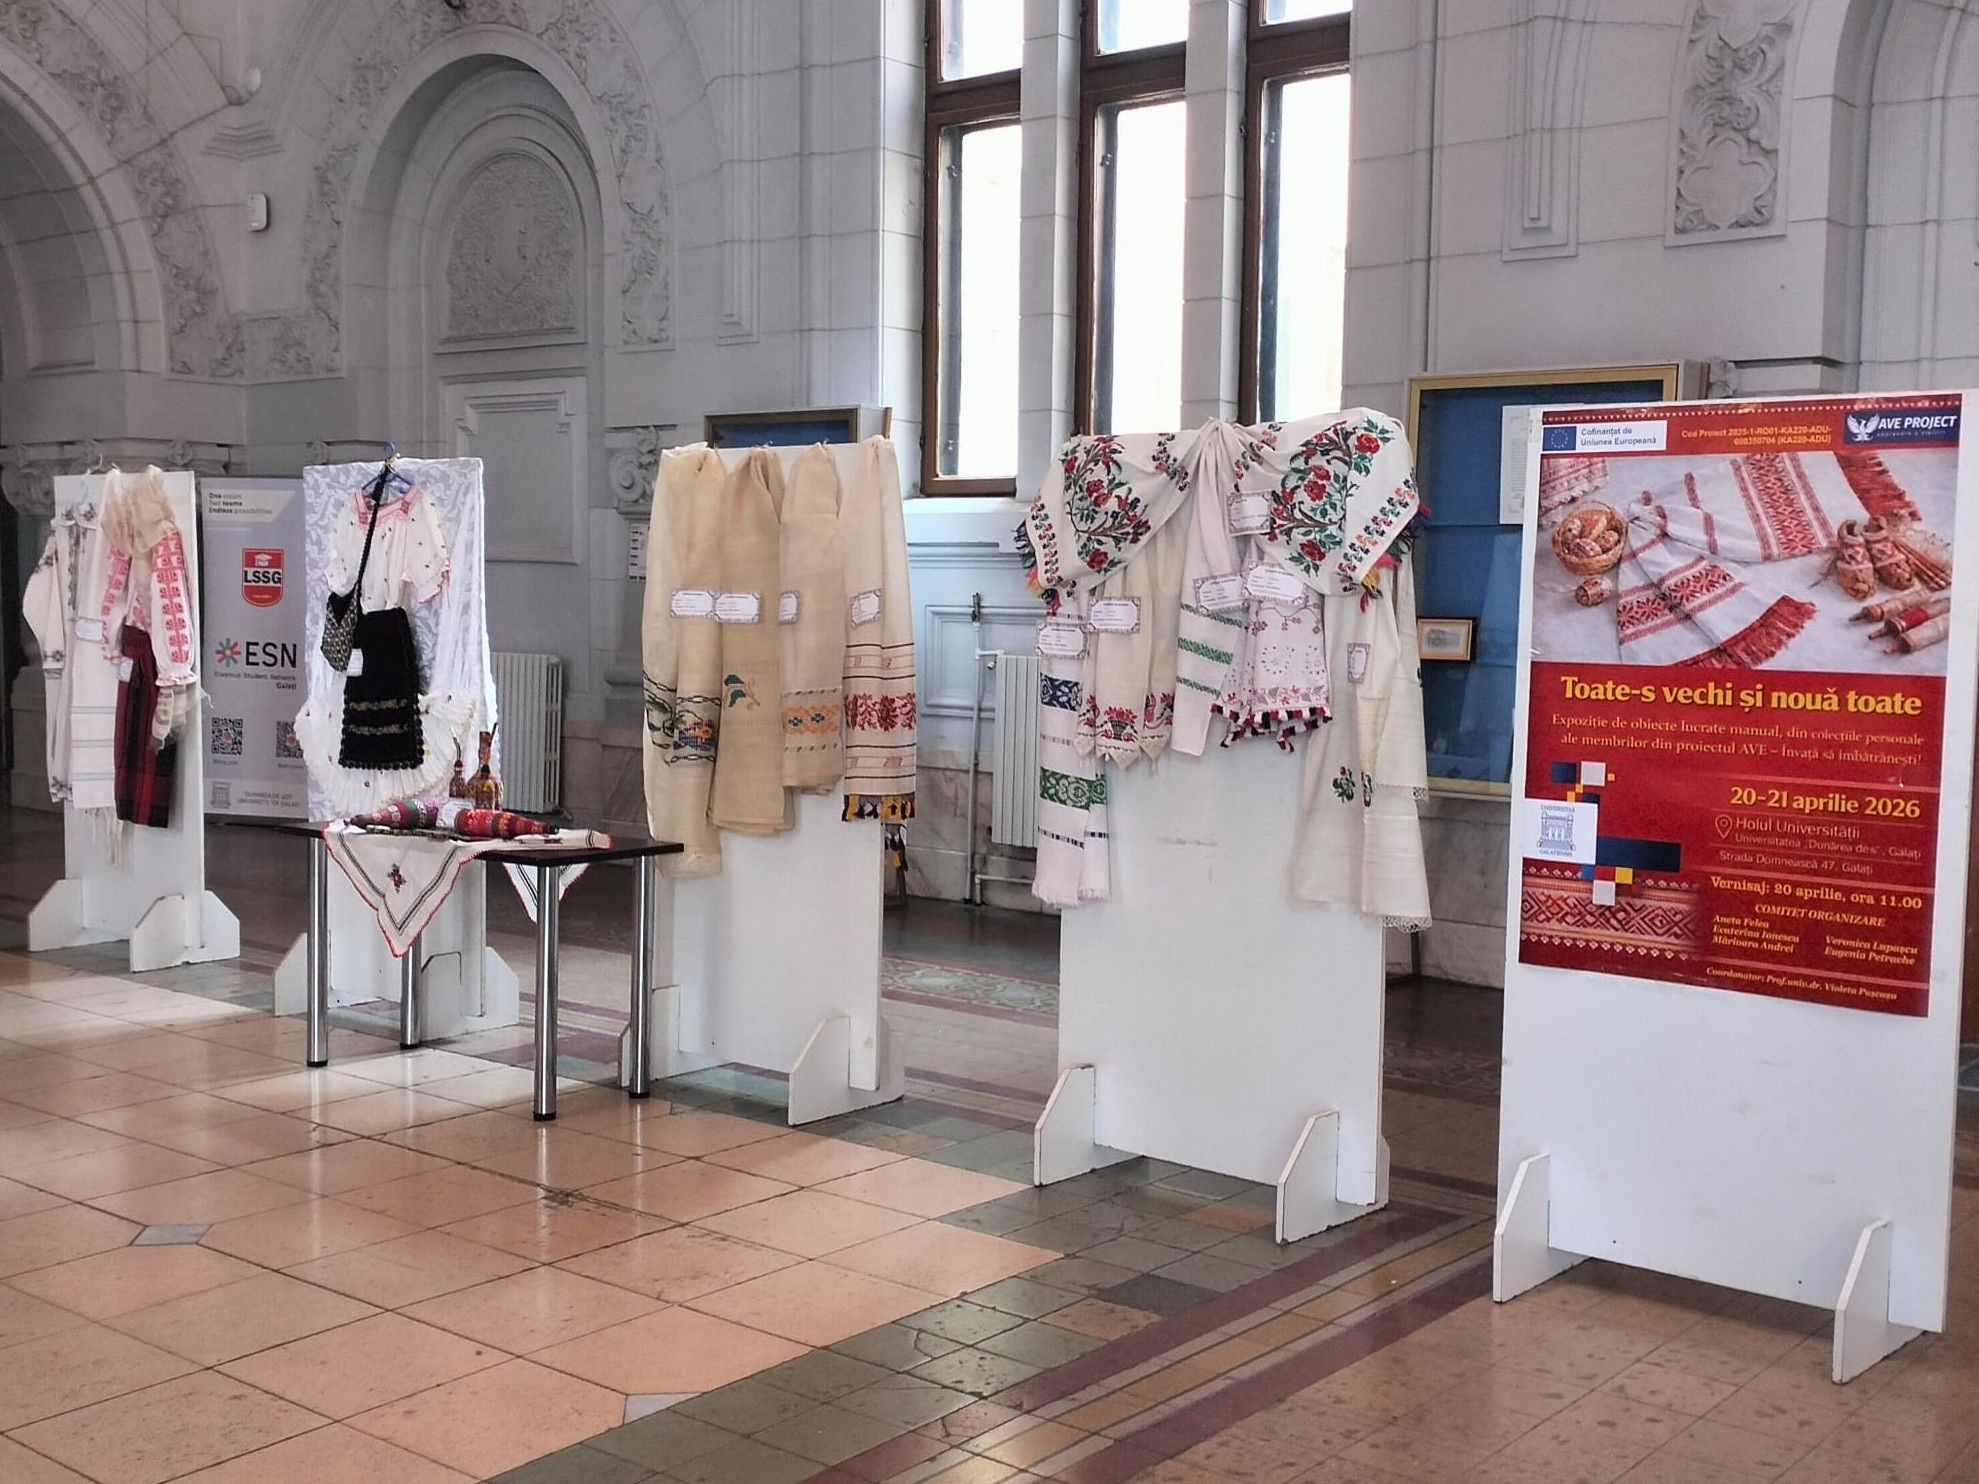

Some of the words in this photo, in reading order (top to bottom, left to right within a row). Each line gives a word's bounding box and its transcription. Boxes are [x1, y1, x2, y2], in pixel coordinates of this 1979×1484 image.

[1878, 418, 1902, 429] AVE
[1904, 415, 1958, 429] PROJECT
[1581, 427, 1621, 437] Cofinanțat
[1622, 427, 1633, 435] de
[1682, 430, 1697, 438] Cod
[1699, 429, 1727, 437] Proiect
[1581, 438, 1613, 446] Uniunea
[1615, 437, 1657, 446] Europeană
[244, 570, 282, 584] LSSG
[245, 641, 297, 668] ESN
[1560, 675, 1656, 702] Toate-s
[1662, 681, 1733, 706] vechi
[1739, 683, 1763, 713] și
[1771, 687, 1840, 711] nouă
[1847, 690, 1922, 715] toate
[1552, 713, 1608, 728] Expoziție
[1611, 716, 1627, 729] de
[1631, 717, 1678, 731] obiecte
[1681, 719, 1726, 734] lucrate
[1730, 725, 1783, 738] manual,
[1787, 726, 1808, 739] din
[1866, 733, 1925, 746] personale
[1561, 732, 1577, 744] ale
[1582, 734, 1648, 748] membrilor
[1651, 738, 1672, 749] din
[1676, 741, 1735, 754] proiectul
[1740, 743, 1767, 756] AVE
[1792, 793, 1859, 814] aprilie
[1864, 797, 1921, 818] 2026
[1736, 816, 1772, 832] Holul
[1735, 833, 1801, 847] Universitatea
[1719, 851, 1753, 864] Strada
[1711, 875, 1770, 896] Vernisaj:
[1774, 883, 1792, 896] 20
[1796, 886, 1846, 902] aprilie,
[1851, 892, 1875, 905] ora
[1880, 895, 1922, 909] 11.00
[1713, 915, 1741, 926] Aneta
[1755, 904, 1807, 918] COMITET
[1808, 909, 1886, 927] ORGANIZARE
[1713, 925, 1760, 938] Ecaterina
[1762, 930, 1800, 943] Ionescu
[1761, 941, 1794, 954] Andrei
[1825, 935, 1871, 949] Veronica
[1824, 946, 1866, 960] Eugenia
[1868, 952, 1916, 966] Petrache
[1825, 982, 1857, 995] Violeta
